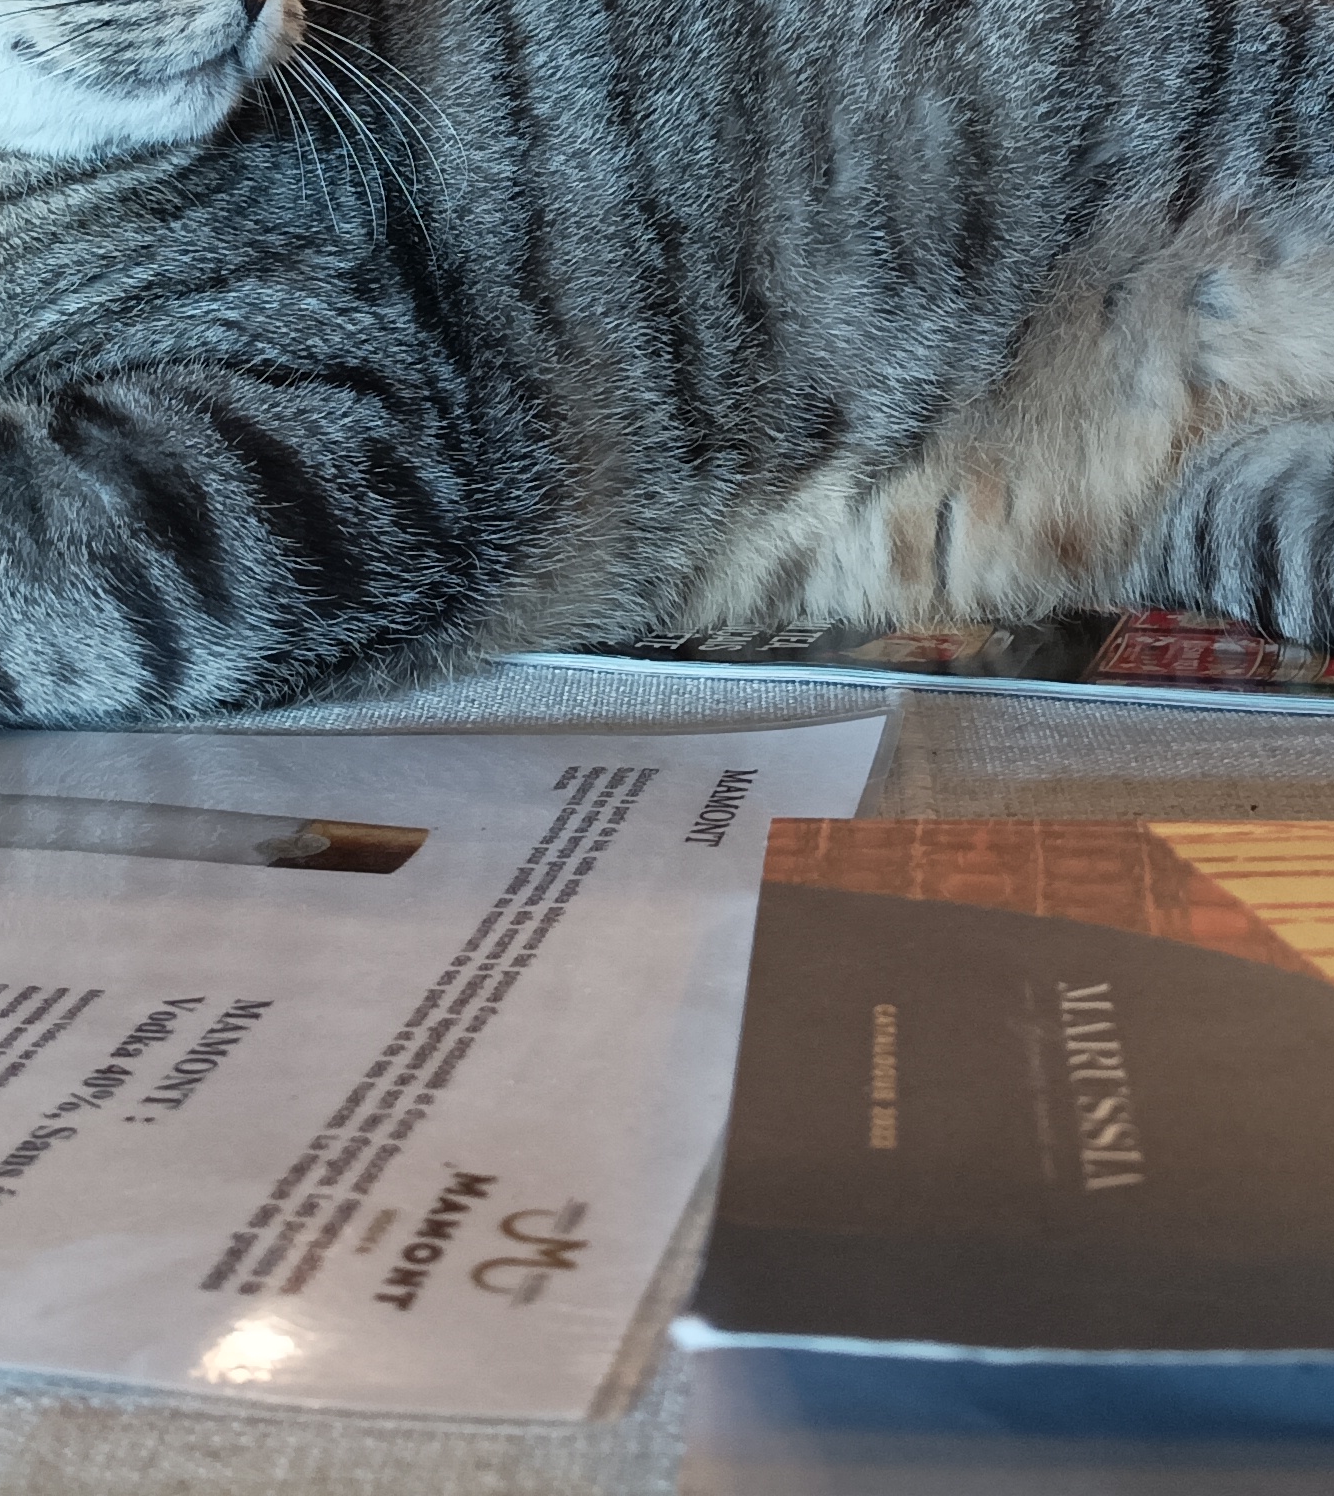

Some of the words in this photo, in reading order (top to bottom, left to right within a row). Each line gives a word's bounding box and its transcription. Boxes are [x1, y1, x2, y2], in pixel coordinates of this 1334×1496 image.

[684, 768, 759, 848] MAMONT
[109, 996, 206, 1058] Vodka
[140, 998, 275, 1110] MAMONT
[42, 1063, 134, 1120] 40%,
[373, 1171, 500, 1311] MAMONT
